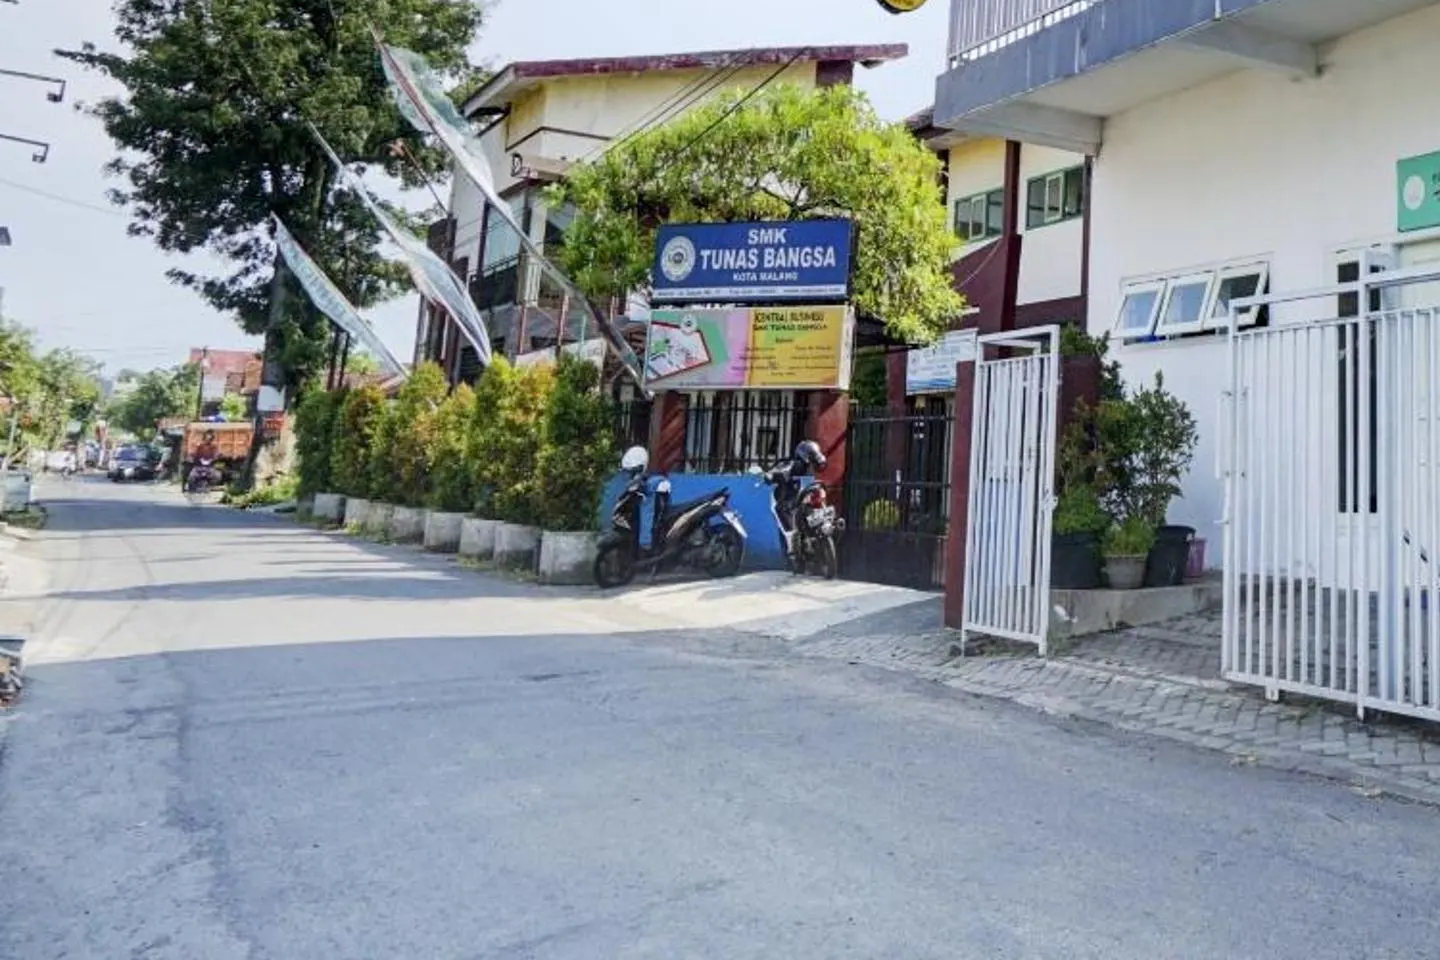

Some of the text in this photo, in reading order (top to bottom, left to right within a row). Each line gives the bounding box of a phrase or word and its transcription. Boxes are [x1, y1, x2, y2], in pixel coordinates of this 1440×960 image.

[748, 228, 787, 244] SMK
[700, 245, 836, 270] TUNAS BANGSA
[732, 271, 799, 281] KOTA MALANG
